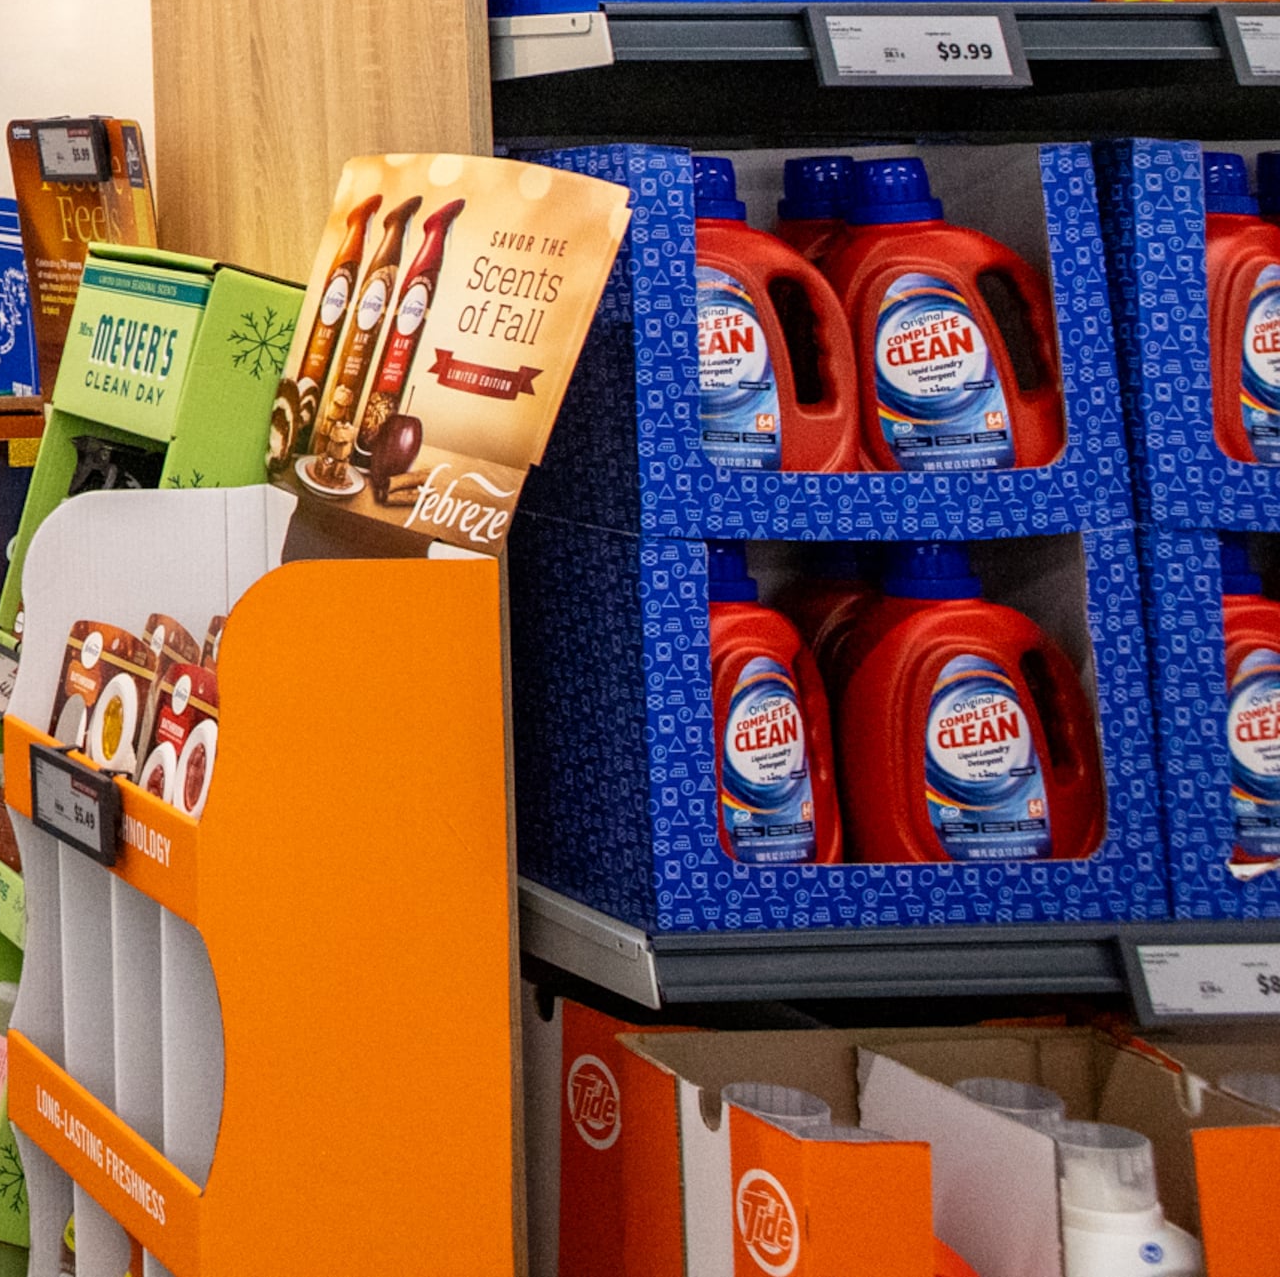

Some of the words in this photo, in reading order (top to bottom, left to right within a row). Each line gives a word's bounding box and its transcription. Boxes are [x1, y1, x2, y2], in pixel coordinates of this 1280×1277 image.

[937, 42, 993, 62] $9.99
[56, 196, 122, 244] Feels
[490, 231, 535, 253] SAVOR
[540, 237, 568, 257] THE
[131, 279, 157, 294] SEASONAL
[157, 284, 178, 296] SCENTS
[466, 256, 564, 303] Scents
[458, 301, 491, 335] of
[488, 304, 545, 345] Fall
[698, 307, 729, 321] iginal
[698, 314, 744, 331] PLETE
[900, 311, 944, 331] Original
[393, 338, 409, 349] AIR
[698, 327, 755, 356] EAN
[887, 316, 961, 347] COMPLETE
[1253, 335, 1280, 355] CLE
[90, 314, 178, 378] MEYER'S
[886, 327, 974, 366] CLEAN
[447, 368, 477, 384] LIMITED
[478, 374, 512, 392] EDITION
[908, 365, 928, 377] Liquid
[930, 360, 963, 372] Laundry
[918, 370, 956, 383] Detergent
[85, 370, 131, 398] CLEAN
[135, 383, 166, 407] DAY
[758, 415, 774, 427] 64
[987, 413, 1002, 425] 64
[403, 463, 509, 543] febreze
[736, 703, 791, 732] COMPLETE
[749, 699, 782, 716] Original
[939, 700, 1008, 729] COMPLETE
[952, 695, 995, 713] Original
[1237, 701, 1280, 723] COMPLE
[734, 714, 798, 752] CLEAN
[937, 712, 1020, 749] CLEAN
[967, 756, 1003, 767] Detergent
[979, 745, 1010, 756] Laundry
[74, 802, 95, 830] $5.49
[123, 813, 172, 868] HNOLOGY
[570, 1073, 618, 1126] Tide
[36, 1084, 104, 1168] LONG-LASTING
[105, 1146, 166, 1226] FRESHNESS
[741, 1191, 793, 1249] Tide
